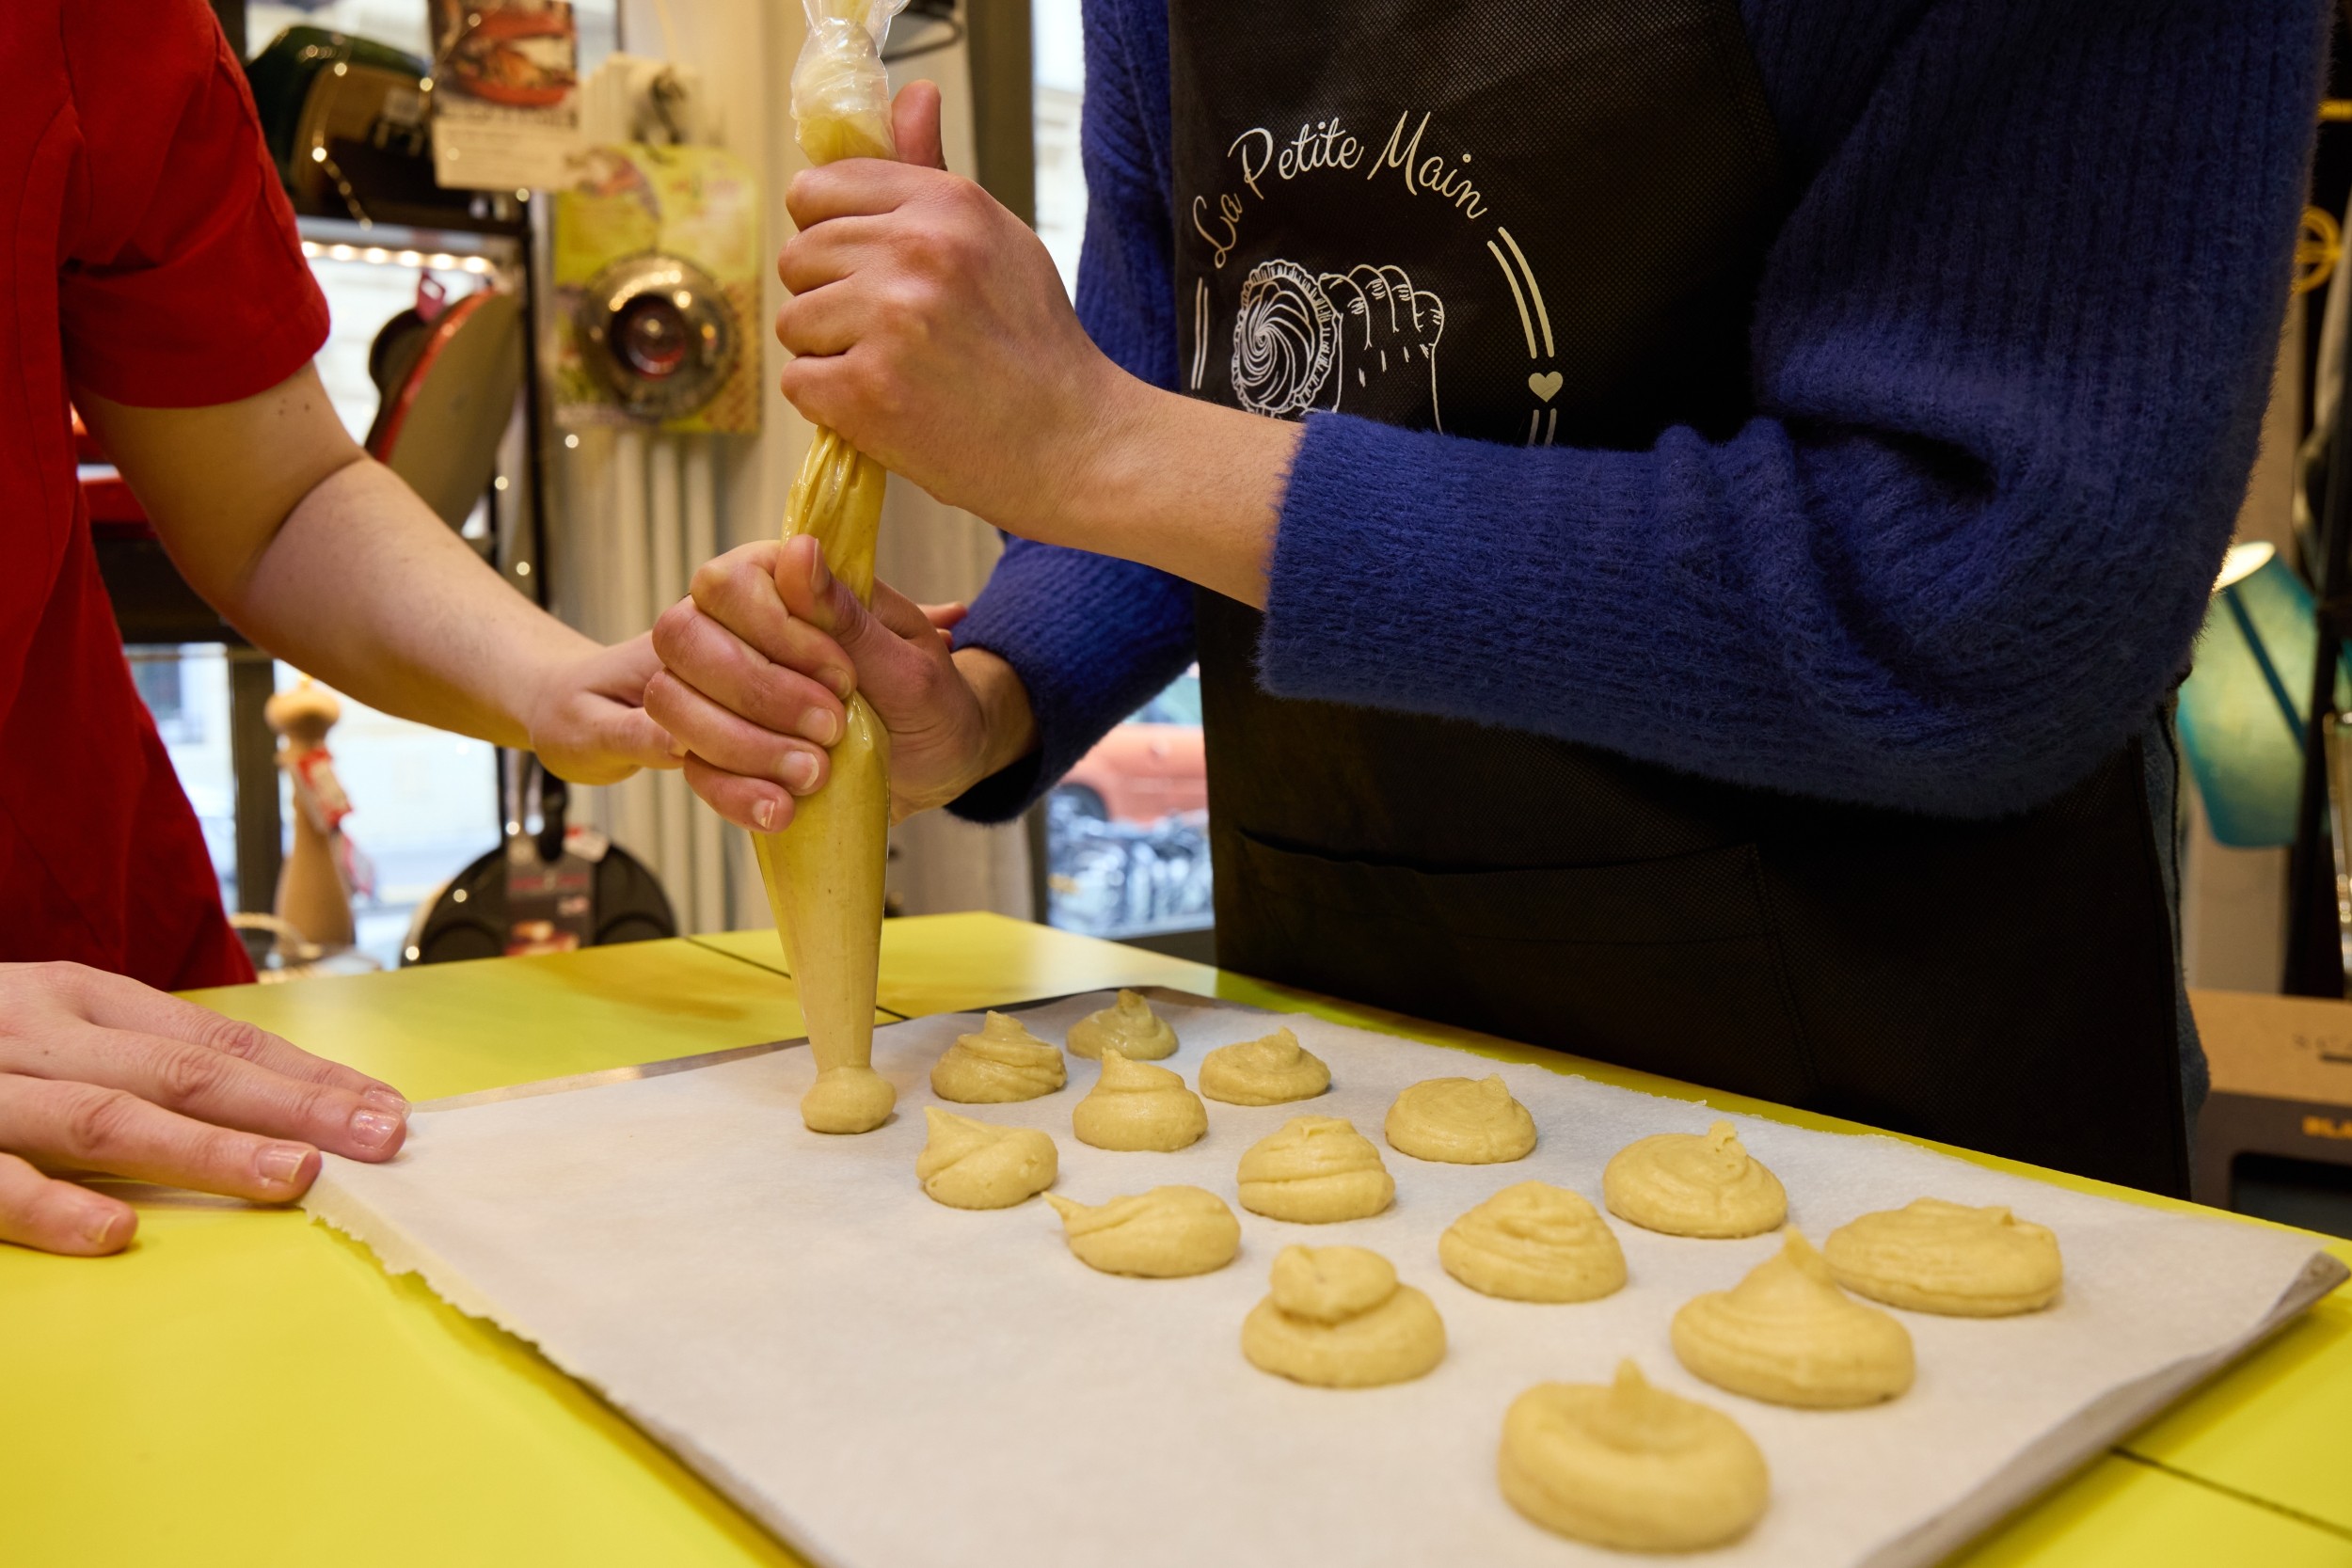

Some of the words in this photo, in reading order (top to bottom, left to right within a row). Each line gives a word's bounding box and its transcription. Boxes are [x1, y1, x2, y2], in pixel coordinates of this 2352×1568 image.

[1193, 194, 1243, 269] La
[1227, 117, 1365, 200] Petite
[1367, 110, 1488, 220] Main
